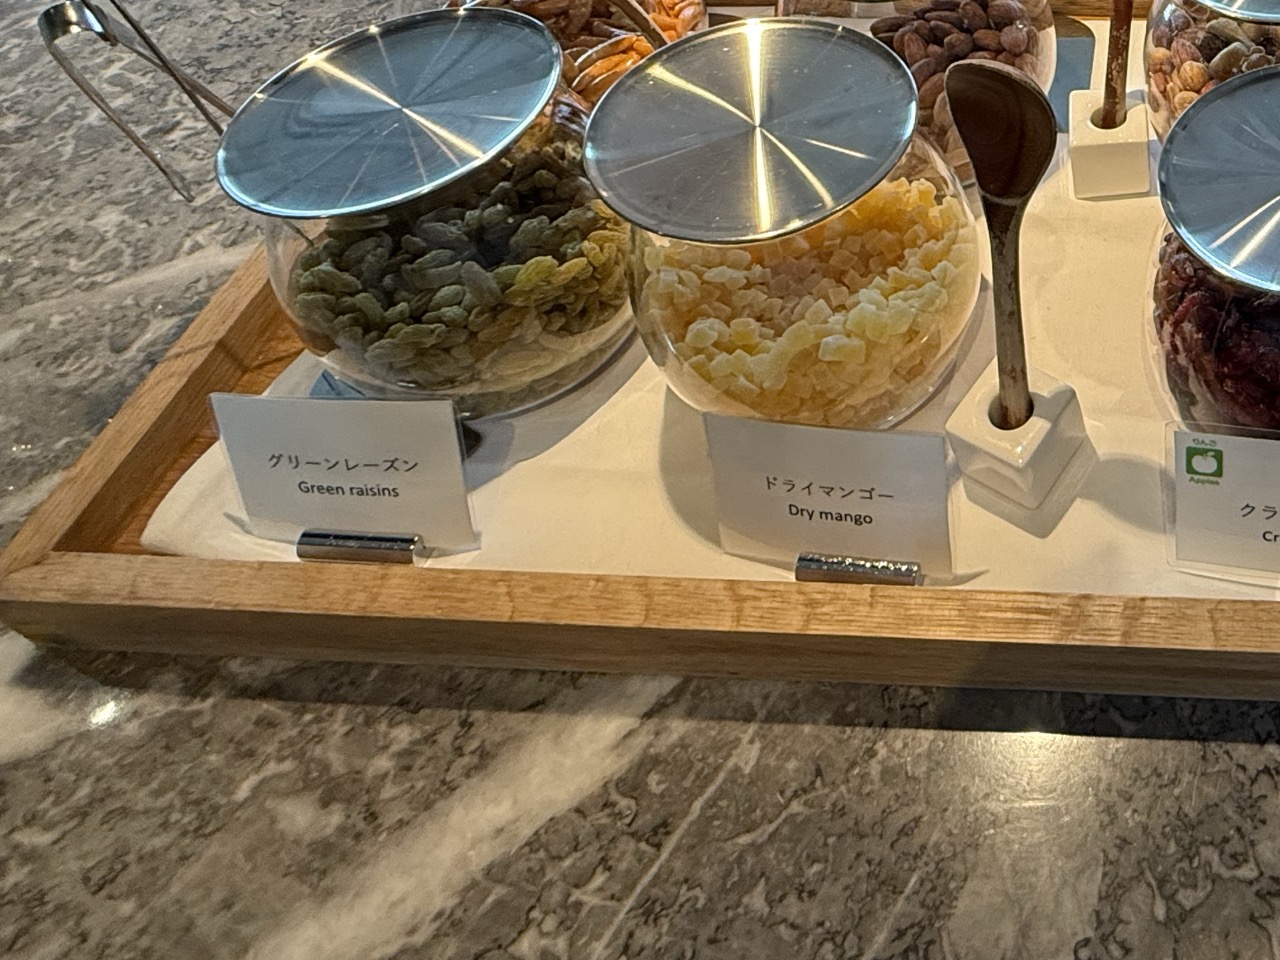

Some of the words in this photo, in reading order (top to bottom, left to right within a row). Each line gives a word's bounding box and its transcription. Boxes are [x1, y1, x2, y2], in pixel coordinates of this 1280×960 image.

[268, 453, 419, 473] グリーンレーズン
[297, 480, 346, 496] Green
[349, 483, 400, 498] raisins
[765, 475, 895, 501] ドライマンゴー
[788, 503, 815, 521] Dry
[819, 510, 873, 527] mango
